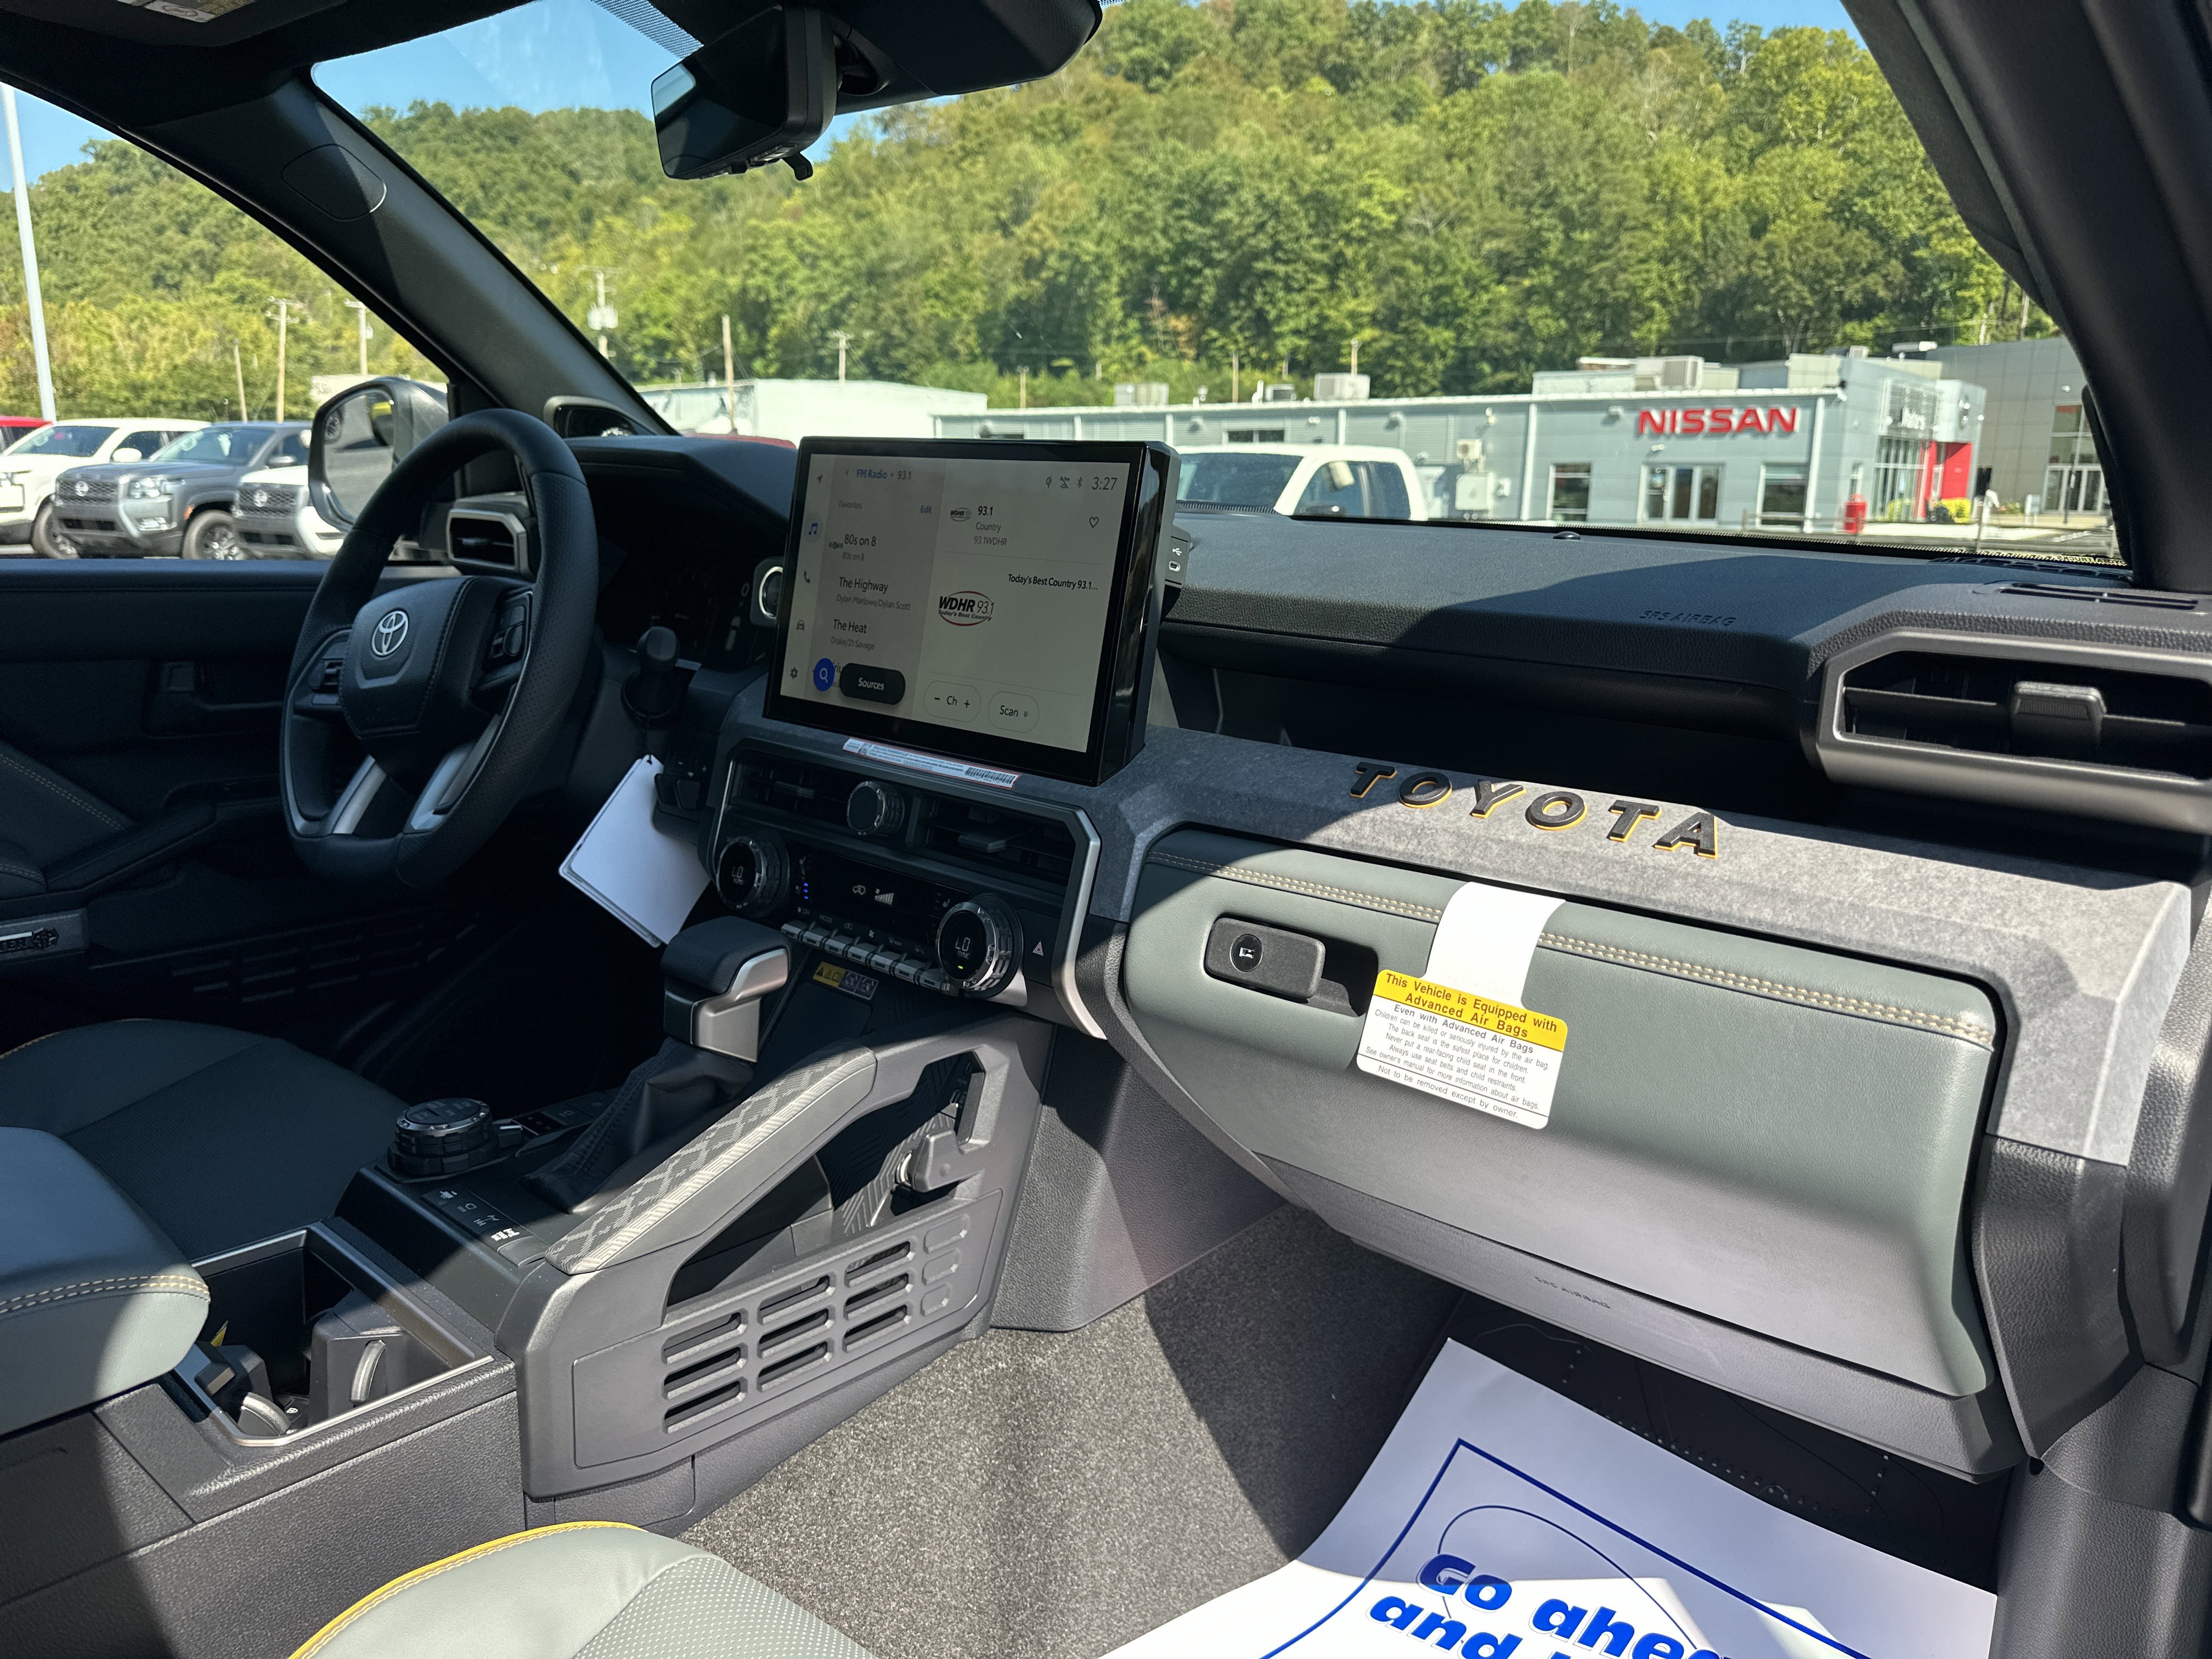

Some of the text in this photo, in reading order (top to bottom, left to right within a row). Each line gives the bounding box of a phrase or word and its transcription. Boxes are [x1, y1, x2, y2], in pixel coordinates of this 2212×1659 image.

[1638, 407, 1798, 434] NISSAN
[856, 469, 912, 480] FM Radio 93.1
[1091, 476, 1118, 490] 3:27
[838, 500, 863, 510] Favorites
[920, 505, 933, 514] Edit
[977, 505, 994, 516] 93.1
[975, 521, 1002, 534] Country
[844, 533, 858, 545] 80s
[859, 537, 870, 546] on
[871, 535, 877, 547] 8
[973, 535, 1008, 546] 93.1WDHR
[839, 577, 889, 595] The Highway
[1008, 573, 1032, 585] Today's
[1032, 575, 1048, 586] Best
[1048, 577, 1077, 589] Country
[836, 594, 852, 604] Dylan
[895, 600, 911, 611] Scott
[939, 596, 995, 615] WDHR 93.1
[938, 609, 957, 618] Today's
[971, 613, 992, 622] Country
[833, 619, 867, 634] The Heat
[855, 640, 876, 651] Savage
[858, 677, 885, 691] Sources
[946, 695, 958, 706] Ch
[999, 704, 1019, 718] Scan
[1349, 761, 1718, 860] TOYOTA
[957, 951, 970, 960] SYNC
[1386, 972, 1557, 1032] This Vehicle is Equipped with
[1404, 992, 1528, 1038] Advanced Air Bags
[1394, 1004, 1533, 1054] Even with Advanced Air Bags
[1375, 1009, 1398, 1022] Children
[1413, 1020, 1420, 1029] be
[1449, 1034, 1476, 1048] seriously
[1477, 1042, 1499, 1054] injured
[1500, 1048, 1509, 1058] by
[1511, 1052, 1522, 1061] the
[1536, 1058, 1549, 1071] bag.
[1389, 1023, 1399, 1032] The
[1401, 1027, 1415, 1038] back
[1417, 1034, 1430, 1043] seat
[1440, 1040, 1450, 1049] the
[1452, 1045, 1471, 1056] safest
[1472, 1051, 1489, 1062] place
[1492, 1056, 1501, 1065] for
[1503, 1060, 1528, 1074] children.
[1385, 1032, 1403, 1043] Never
[1404, 1040, 1414, 1048] put
[1456, 1056, 1471, 1066] child
[1472, 1062, 1487, 1071] seat
[1497, 1069, 1508, 1078] the
[1510, 1072, 1526, 1084] front.
[1389, 1044, 1517, 1092] Always use seat belts and child restraints.
[1365, 1046, 1377, 1056] See
[1379, 1052, 1401, 1064] owner's
[1403, 1060, 1425, 1071] manual
[1426, 1066, 1435, 1075] for
[1437, 1071, 1453, 1081] more
[1455, 1076, 1488, 1093] information
[1490, 1088, 1509, 1099] about
[1522, 1097, 1539, 1110] bags.
[1378, 1064, 1391, 1075] Not
[1404, 1073, 1413, 1082] be
[1417, 1079, 1448, 1094] removed
[1451, 1091, 1476, 1104] except
[1479, 1099, 1489, 1109] by
[1492, 1105, 1518, 1119] owner.
[1416, 1552, 1513, 1613] Go
[1365, 1594, 1523, 1659] and
[1528, 1598, 1733, 1659] ahe
